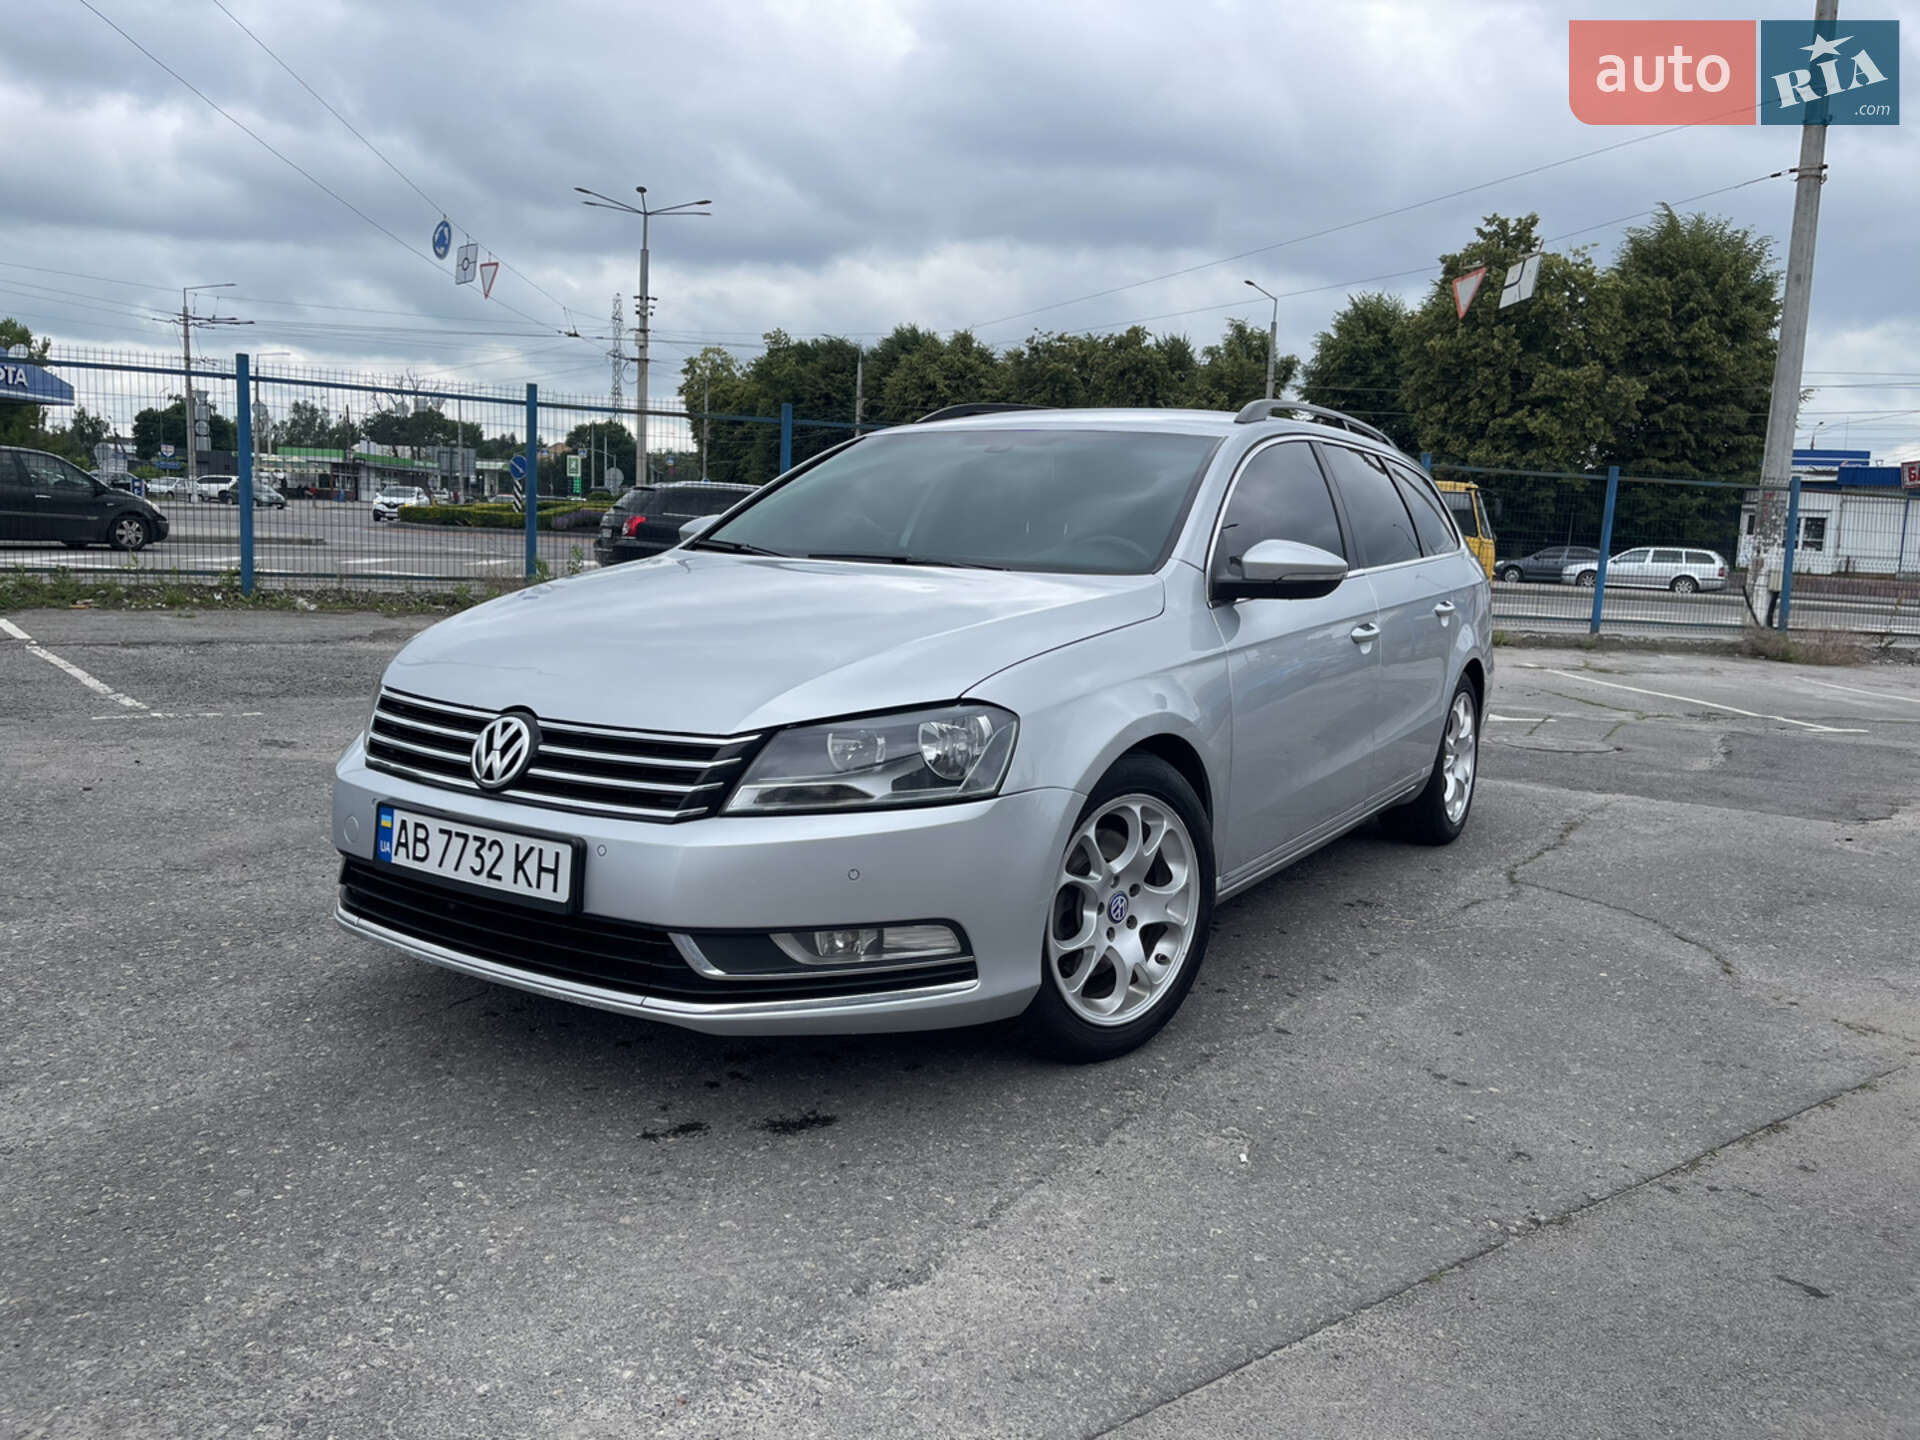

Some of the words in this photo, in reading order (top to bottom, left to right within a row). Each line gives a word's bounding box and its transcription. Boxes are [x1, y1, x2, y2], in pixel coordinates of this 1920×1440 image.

[380, 840, 391, 854] UA
[393, 819, 431, 863] AB
[437, 828, 504, 882] 7732
[513, 842, 561, 893] KH
